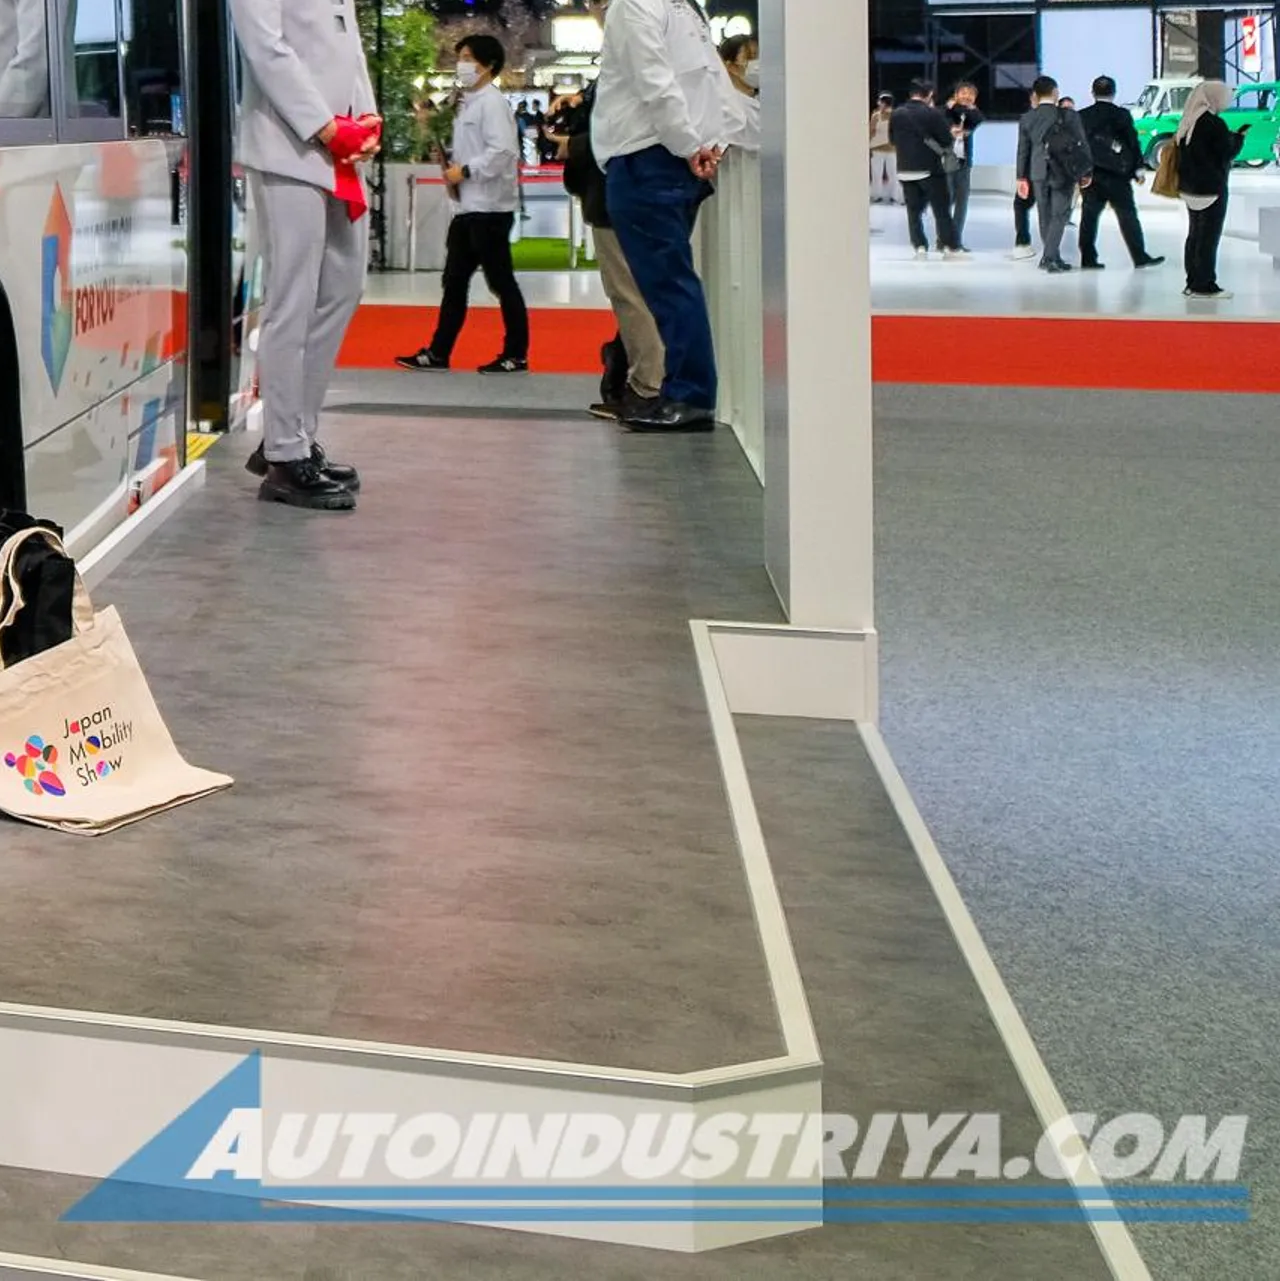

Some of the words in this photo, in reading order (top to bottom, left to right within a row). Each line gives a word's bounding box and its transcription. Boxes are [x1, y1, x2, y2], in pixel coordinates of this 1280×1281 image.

[63, 706, 112, 739] Japan
[69, 720, 133, 765] Mobility
[76, 755, 122, 786] Show
